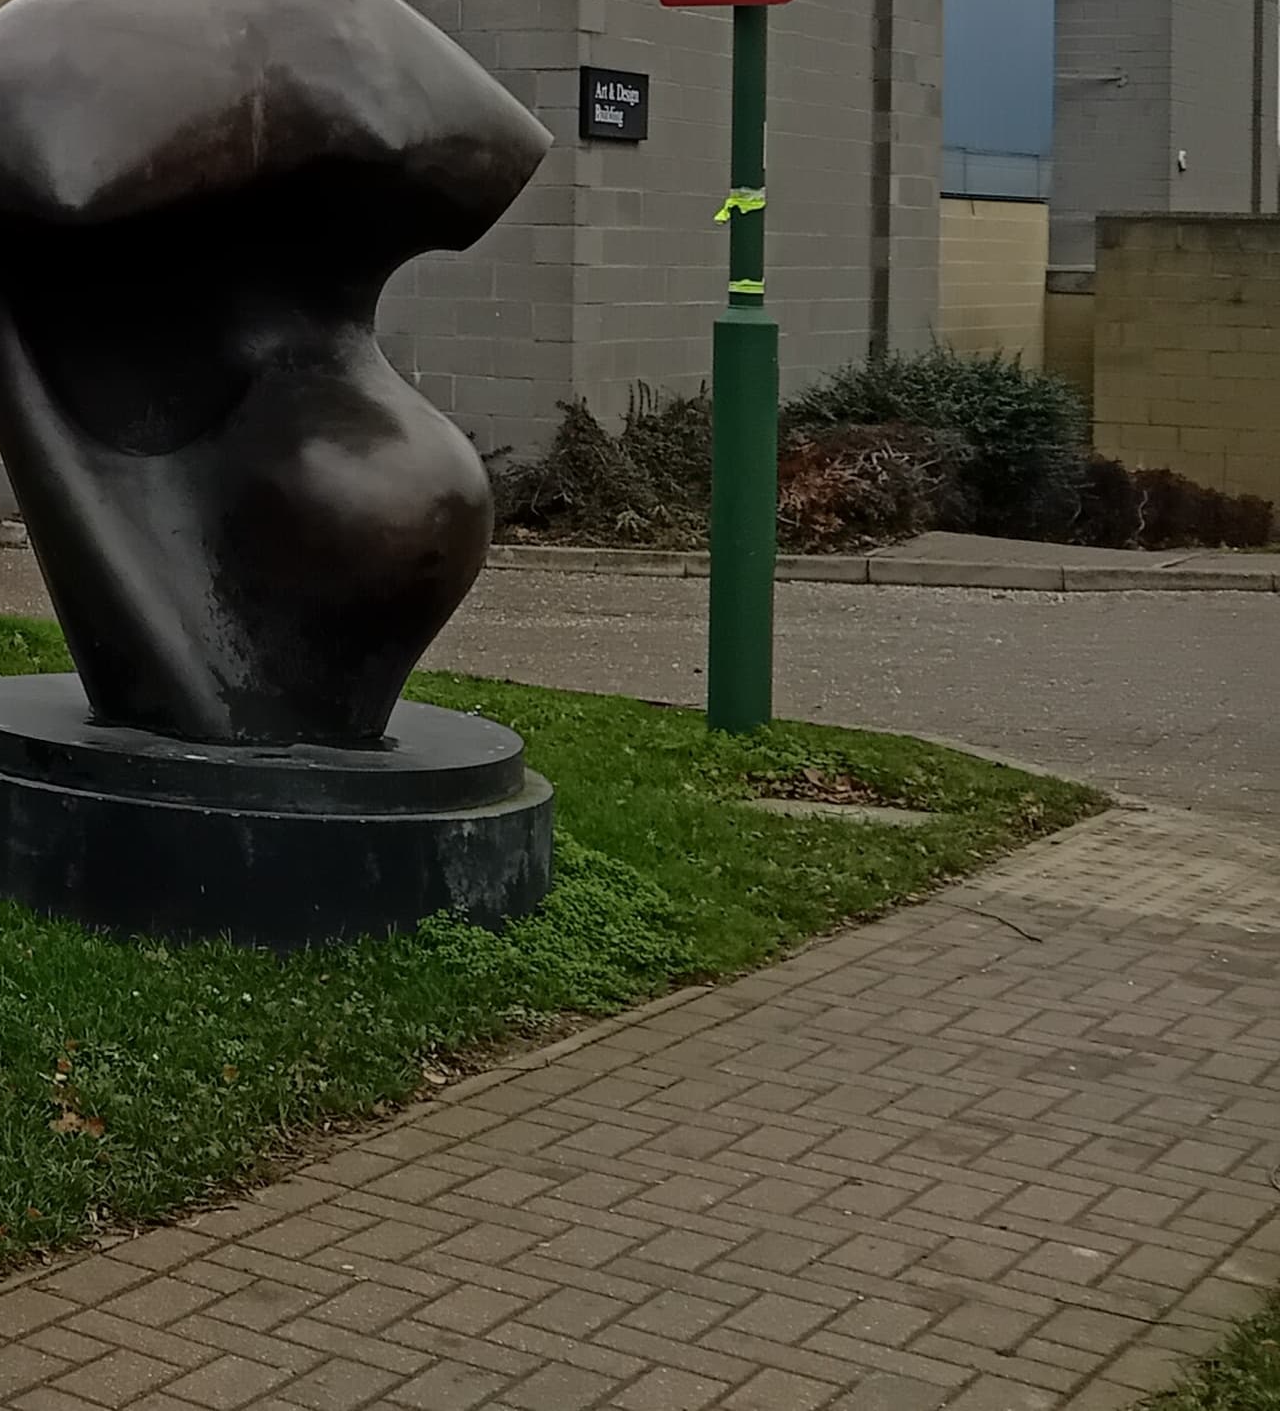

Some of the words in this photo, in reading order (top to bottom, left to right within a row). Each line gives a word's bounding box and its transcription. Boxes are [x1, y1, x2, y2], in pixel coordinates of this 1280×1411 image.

[594, 81, 608, 100] Art
[609, 82, 615, 101] &
[616, 83, 640, 106] Design
[594, 103, 624, 128] Building
